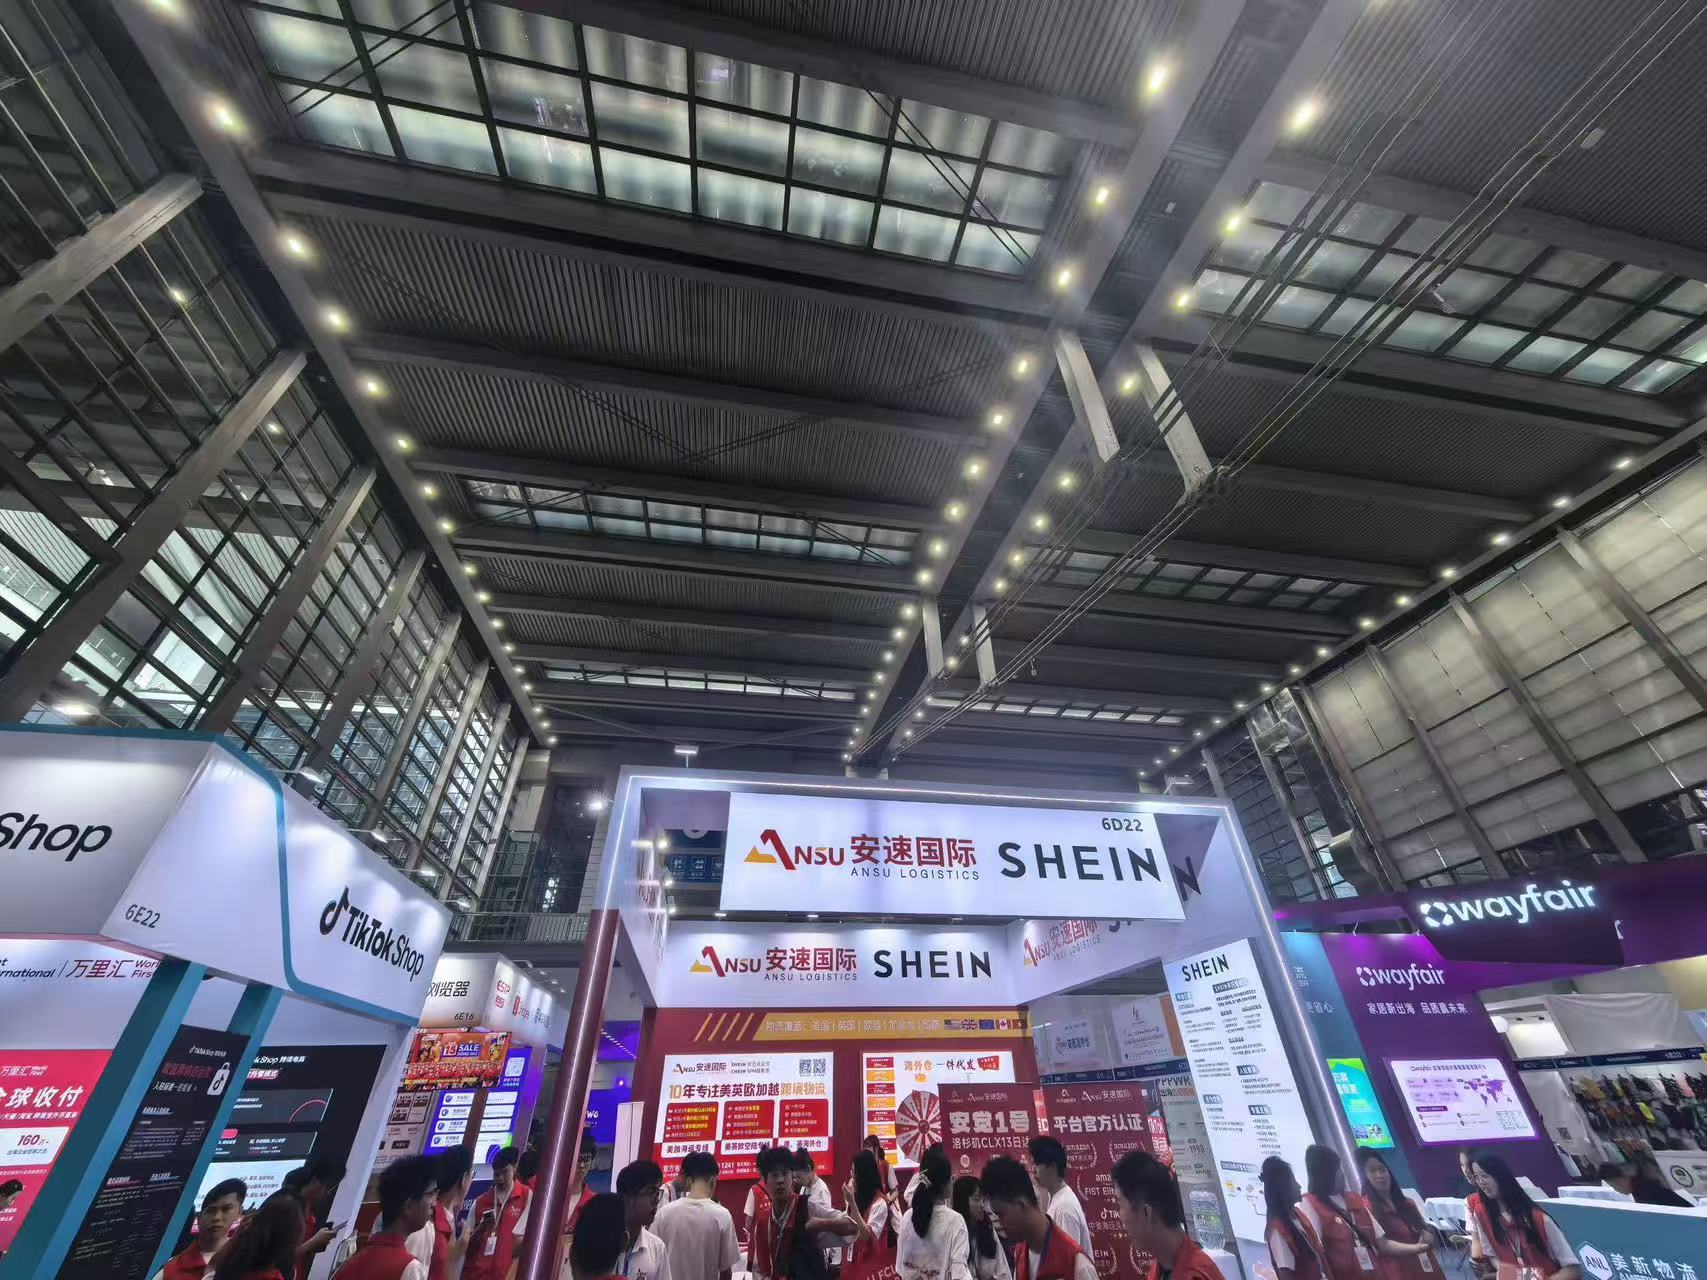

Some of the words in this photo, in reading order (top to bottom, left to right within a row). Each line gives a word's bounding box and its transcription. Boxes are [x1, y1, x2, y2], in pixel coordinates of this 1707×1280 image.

[1101, 816, 1144, 833] 6D22
[0, 812, 113, 862] Shop
[850, 834, 977, 867] 安速国际
[998, 842, 1162, 882] SHEIN
[850, 866, 894, 878] ANSU
[900, 868, 980, 881] LOGISTICS
[1451, 879, 1597, 924] wayfair
[125, 903, 161, 929] 6E22
[342, 905, 396, 958] TikTok
[395, 933, 426, 982] Shop
[65, 959, 134, 978] 万里汇
[765, 946, 858, 972] 安速国际
[873, 949, 992, 979] SHEIN
[1181, 953, 1230, 982] SHEIN
[131, 969, 154, 978] Firs
[764, 973, 796, 981] ANSU
[800, 973, 858, 981] LOGISTICS
[1371, 962, 1446, 991] wayfair
[453, 1012, 474, 1021] 6E16
[1366, 1002, 1416, 1015] 家居新出海
[1420, 1002, 1468, 1015] 品质赢未来
[260, 1056, 279, 1064] Shop
[696, 1062, 727, 1072] 安速国际
[904, 1060, 933, 1072] 海外仓
[936, 1059, 976, 1071] 一件代发
[669, 1082, 826, 1100] 10年专注美英欧加越跨境物流
[1101, 1089, 1131, 1099] 安速国际
[1053, 1113, 1144, 1133] 平台官方认证
[1113, 1142, 1139, 1150] amazon
[1095, 1174, 1113, 1182] ama
[1102, 1186, 1117, 1196] Elit
